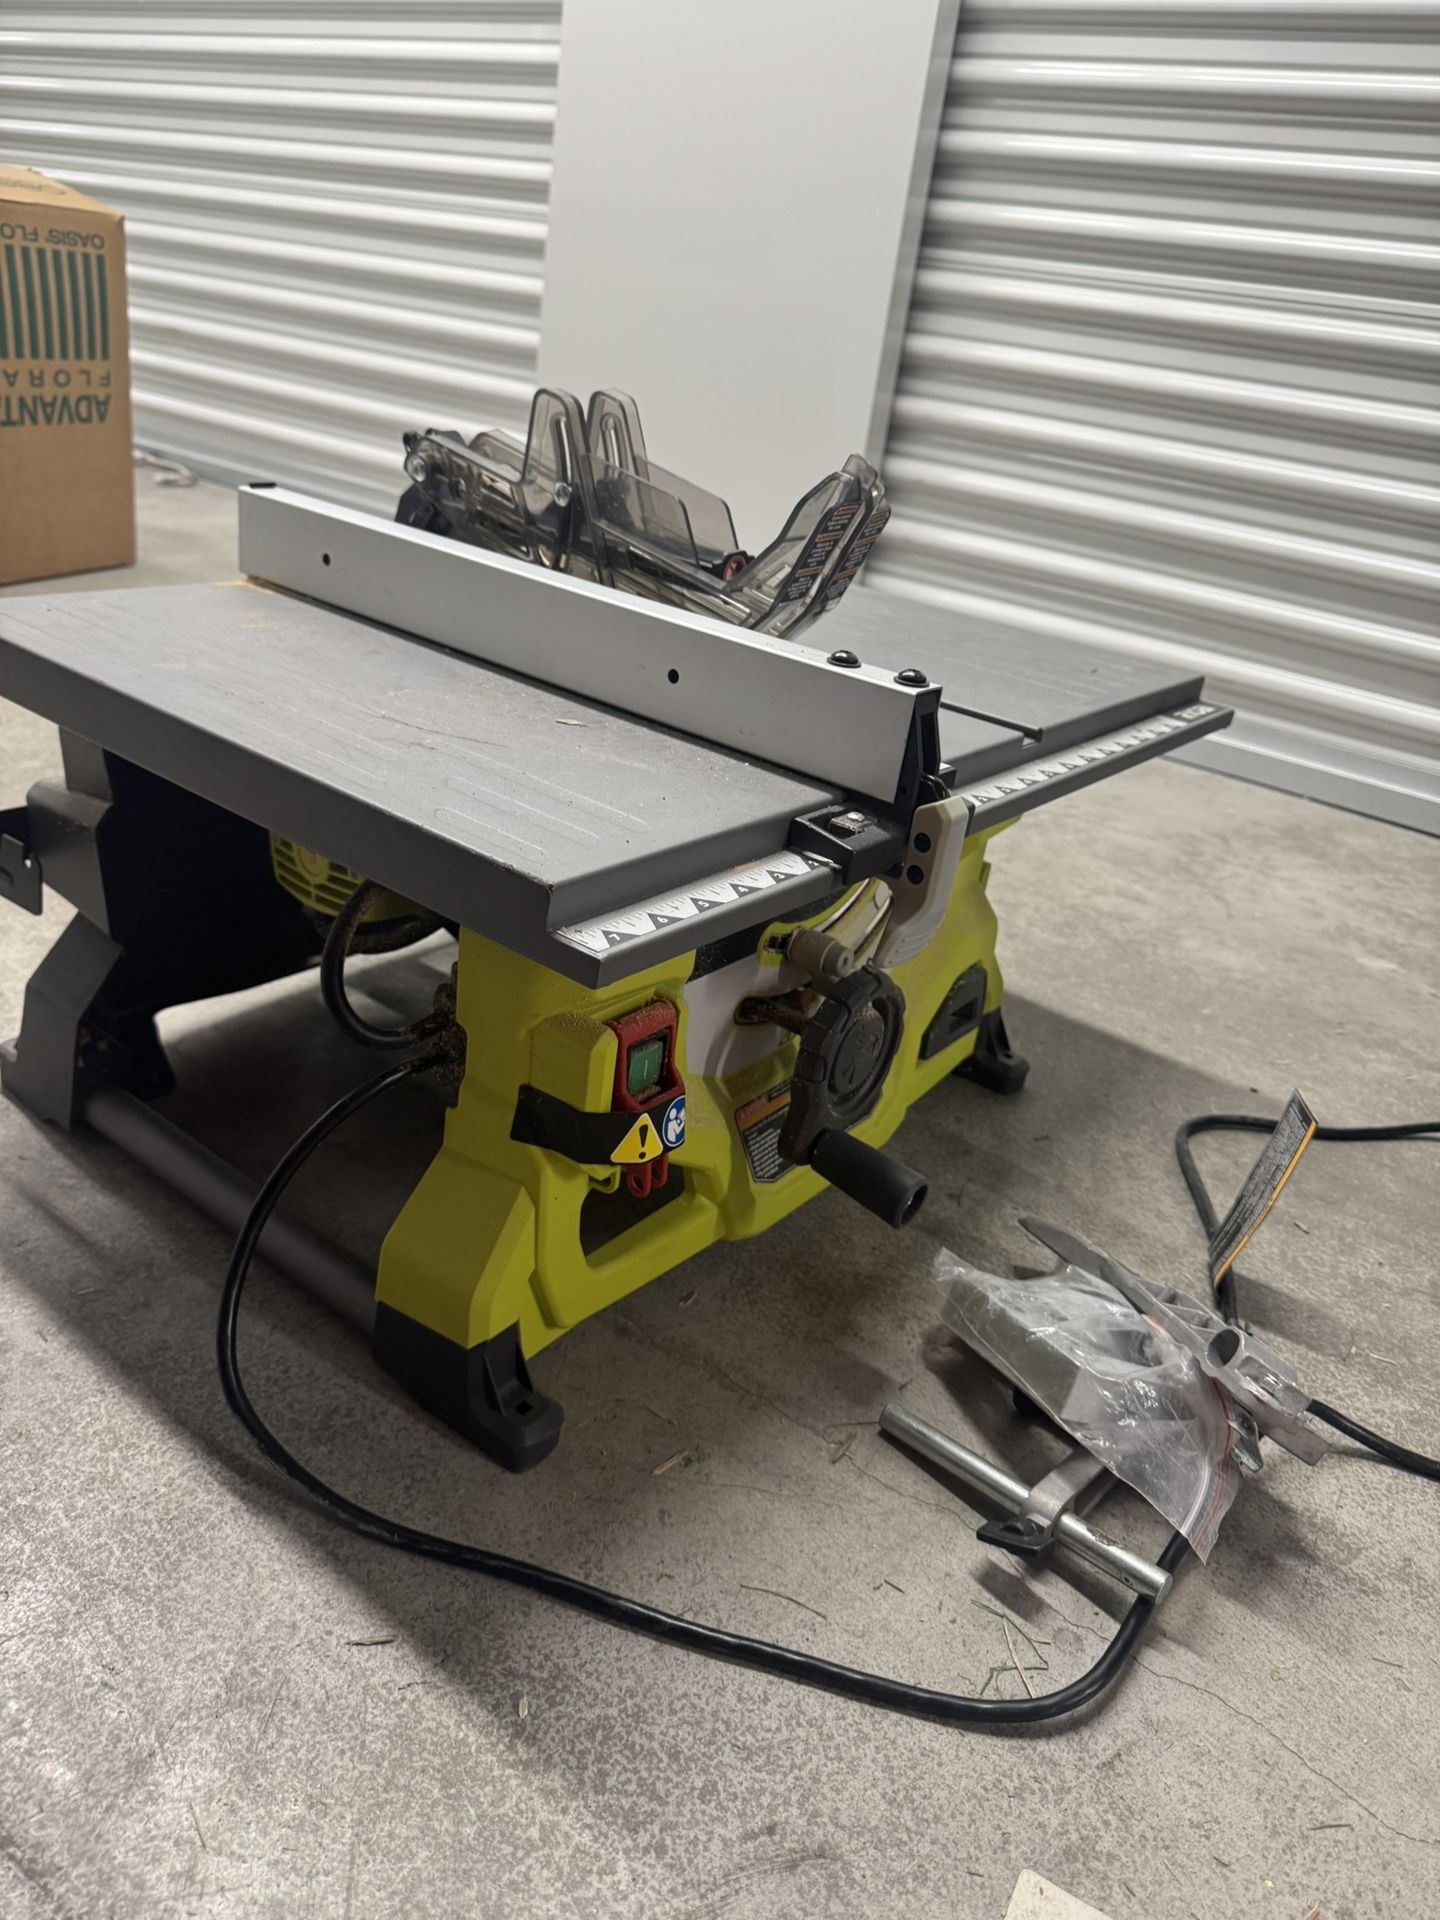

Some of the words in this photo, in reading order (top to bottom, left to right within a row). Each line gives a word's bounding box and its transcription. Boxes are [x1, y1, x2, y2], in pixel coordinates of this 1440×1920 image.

[46, 227, 105, 250] OASIS
[4, 369, 111, 388] FLORA
[0, 394, 112, 427] ADVANT
[658, 916, 668, 924] 6
